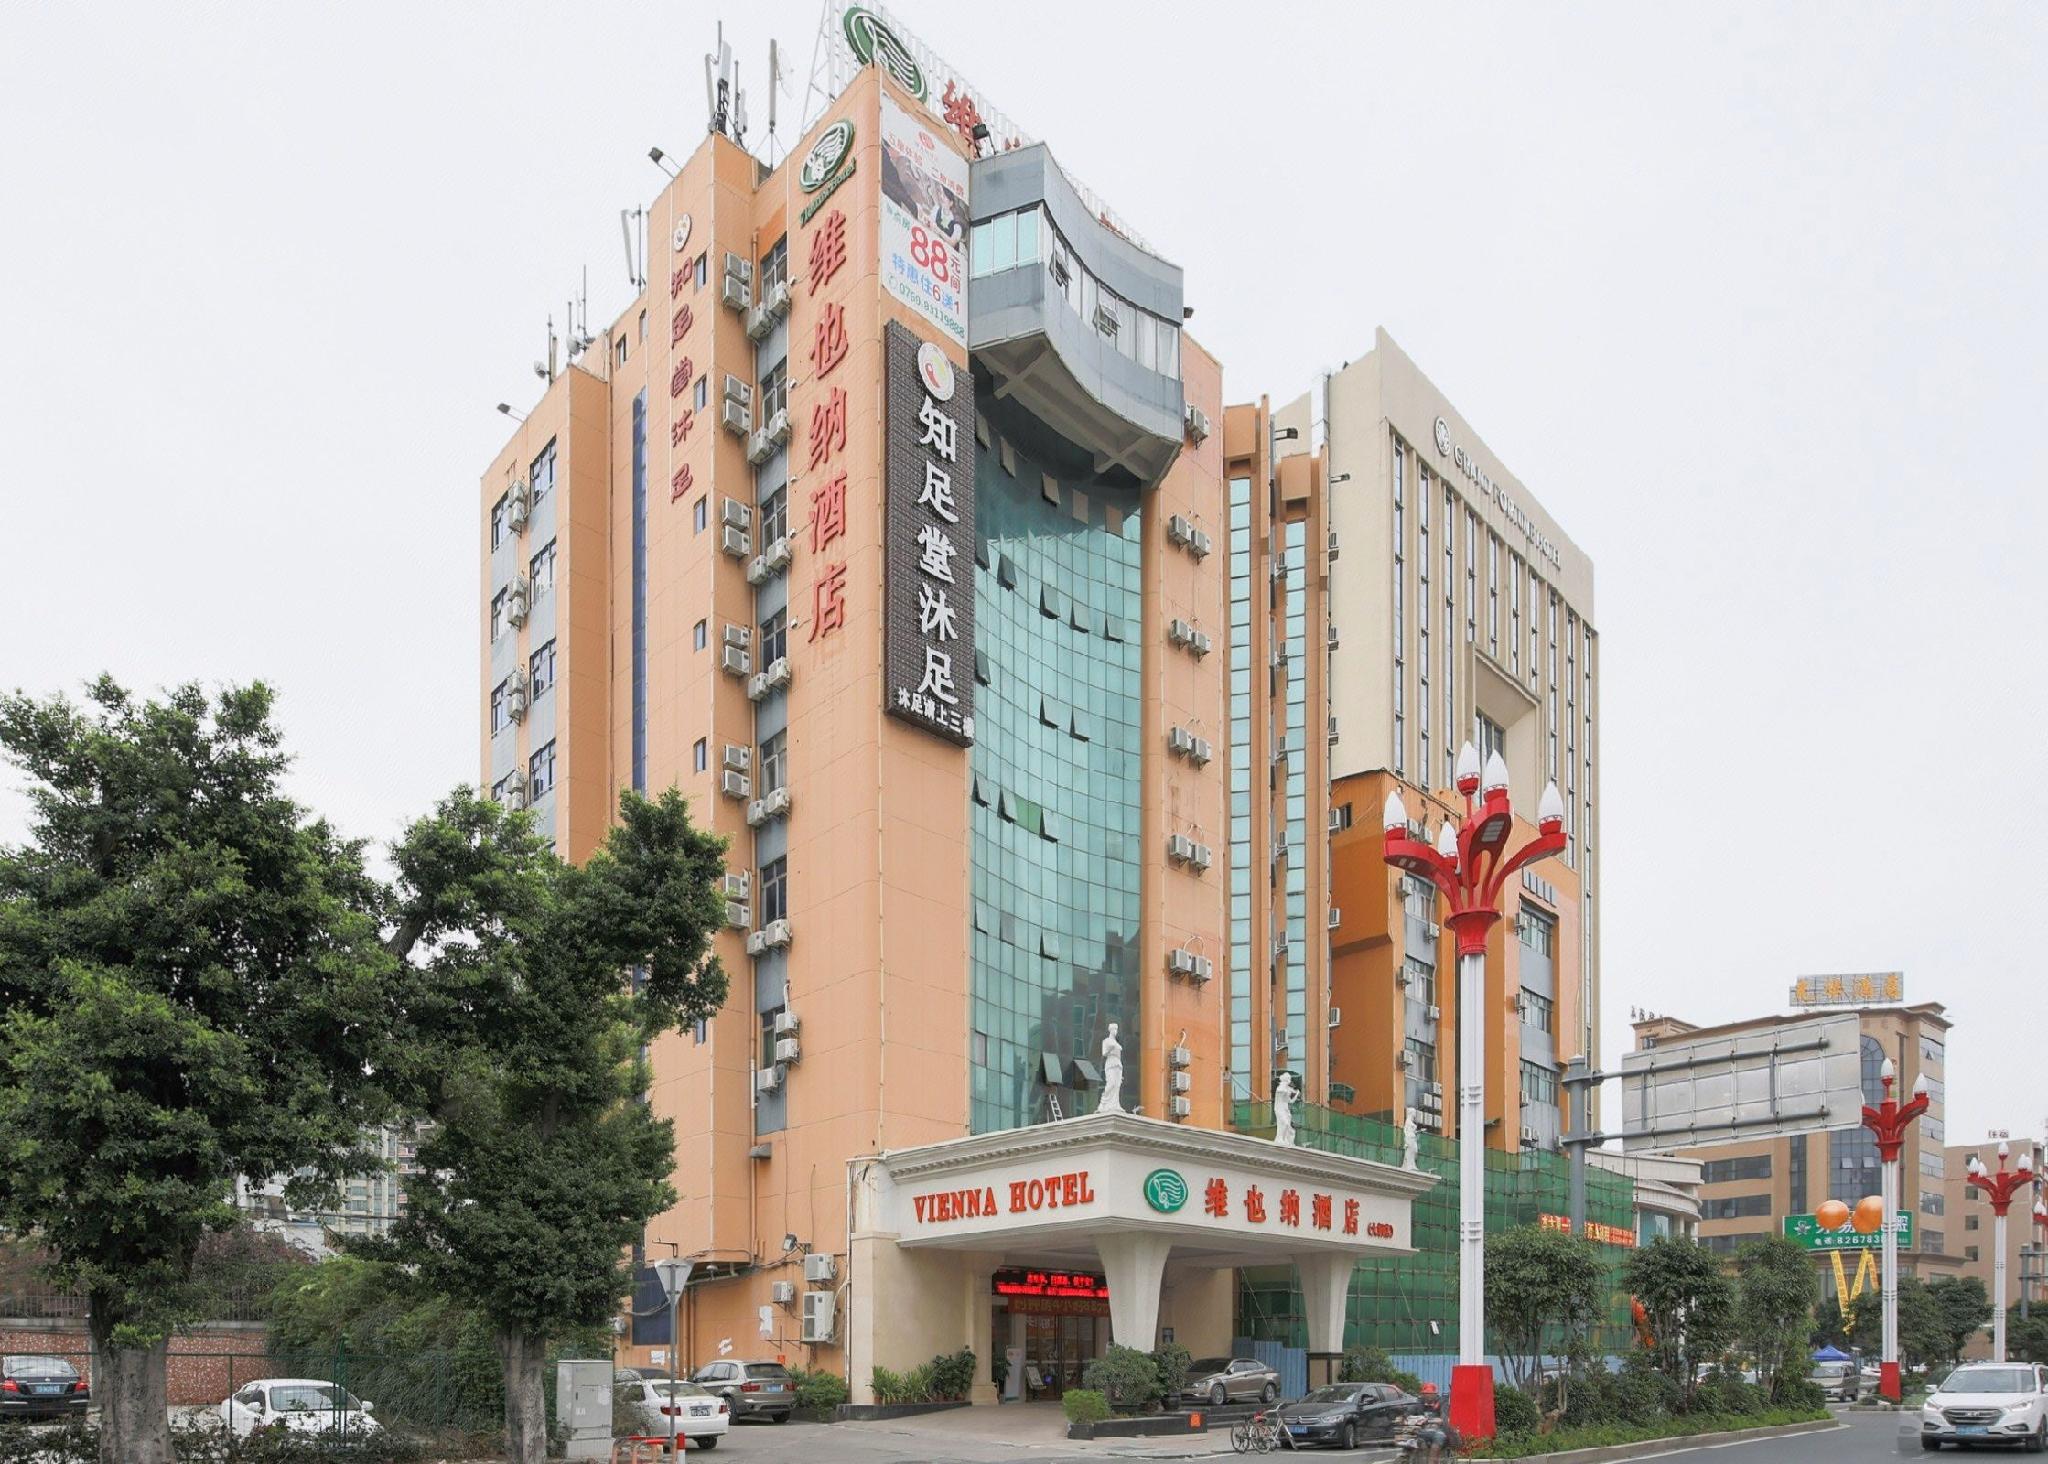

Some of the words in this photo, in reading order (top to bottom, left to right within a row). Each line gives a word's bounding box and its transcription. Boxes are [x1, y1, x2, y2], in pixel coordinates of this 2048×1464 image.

[910, 225, 949, 283] 88
[670, 256, 694, 504] 知足堂沐足
[808, 208, 849, 644] 维也纳酒店
[917, 393, 959, 705] 知足堂沐足
[912, 1186, 998, 1223] VIENNA
[1009, 1171, 1095, 1214] HOTEL
[1204, 1177, 1361, 1235] 维也纳酒店
